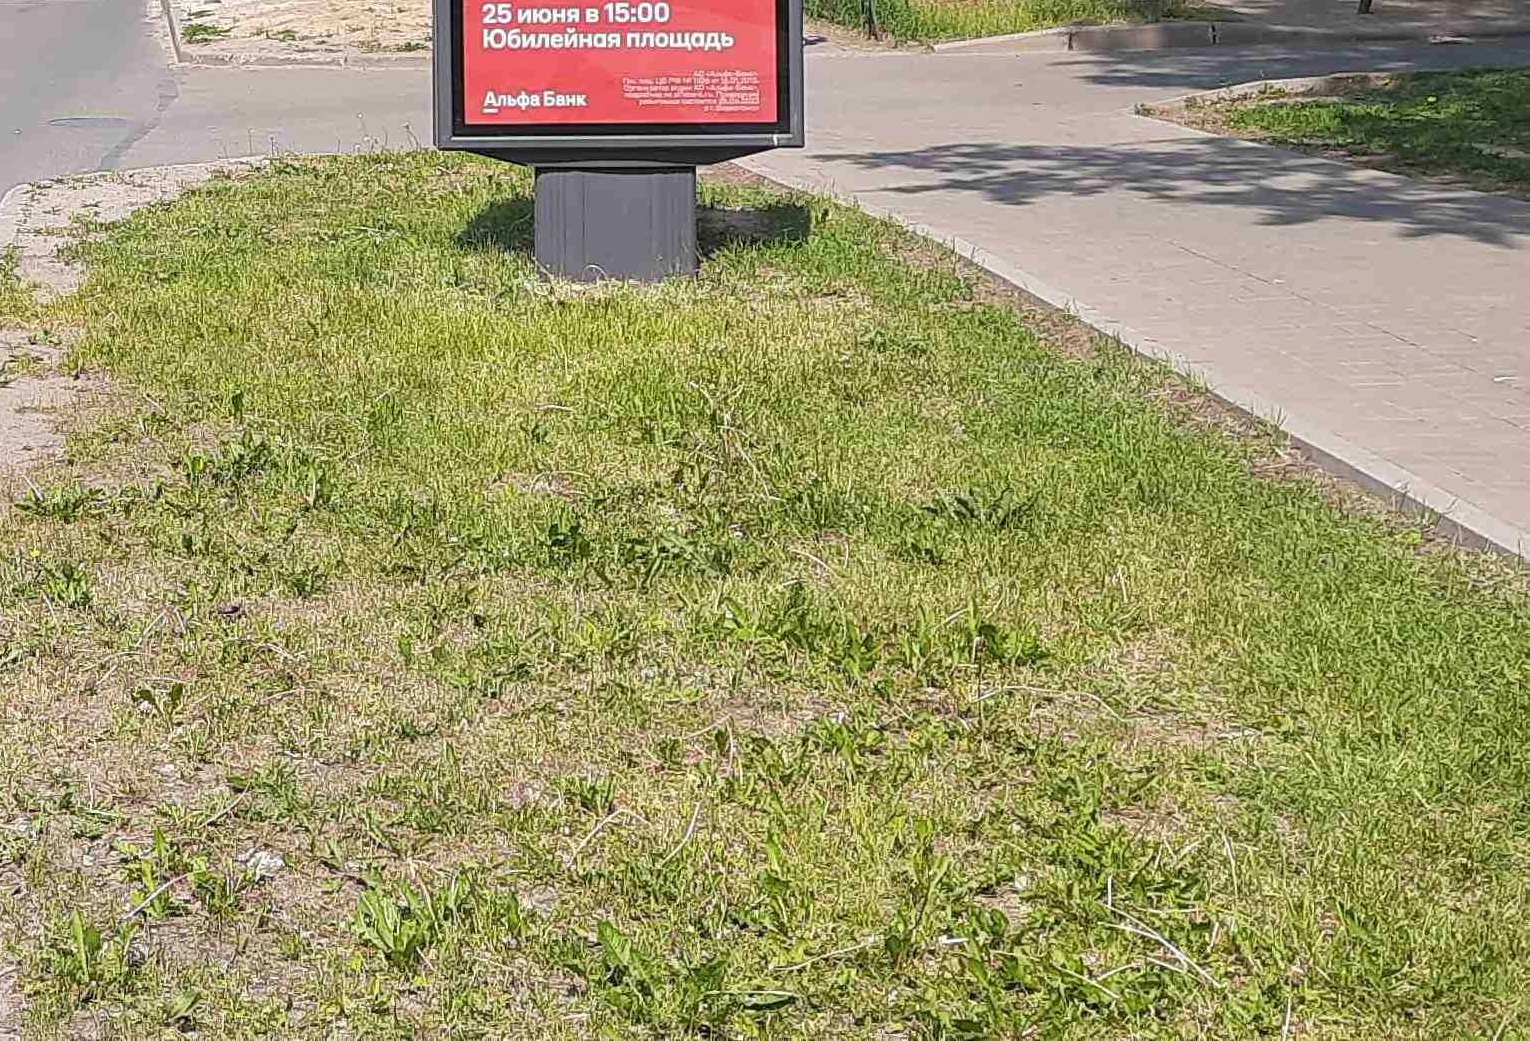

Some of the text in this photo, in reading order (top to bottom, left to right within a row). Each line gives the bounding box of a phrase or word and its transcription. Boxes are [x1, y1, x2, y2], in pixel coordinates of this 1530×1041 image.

[481, 2, 671, 24] 25 июня в 15:00
[482, 26, 735, 52] Юбилейная площадь
[483, 90, 588, 111] Альфа Банк
